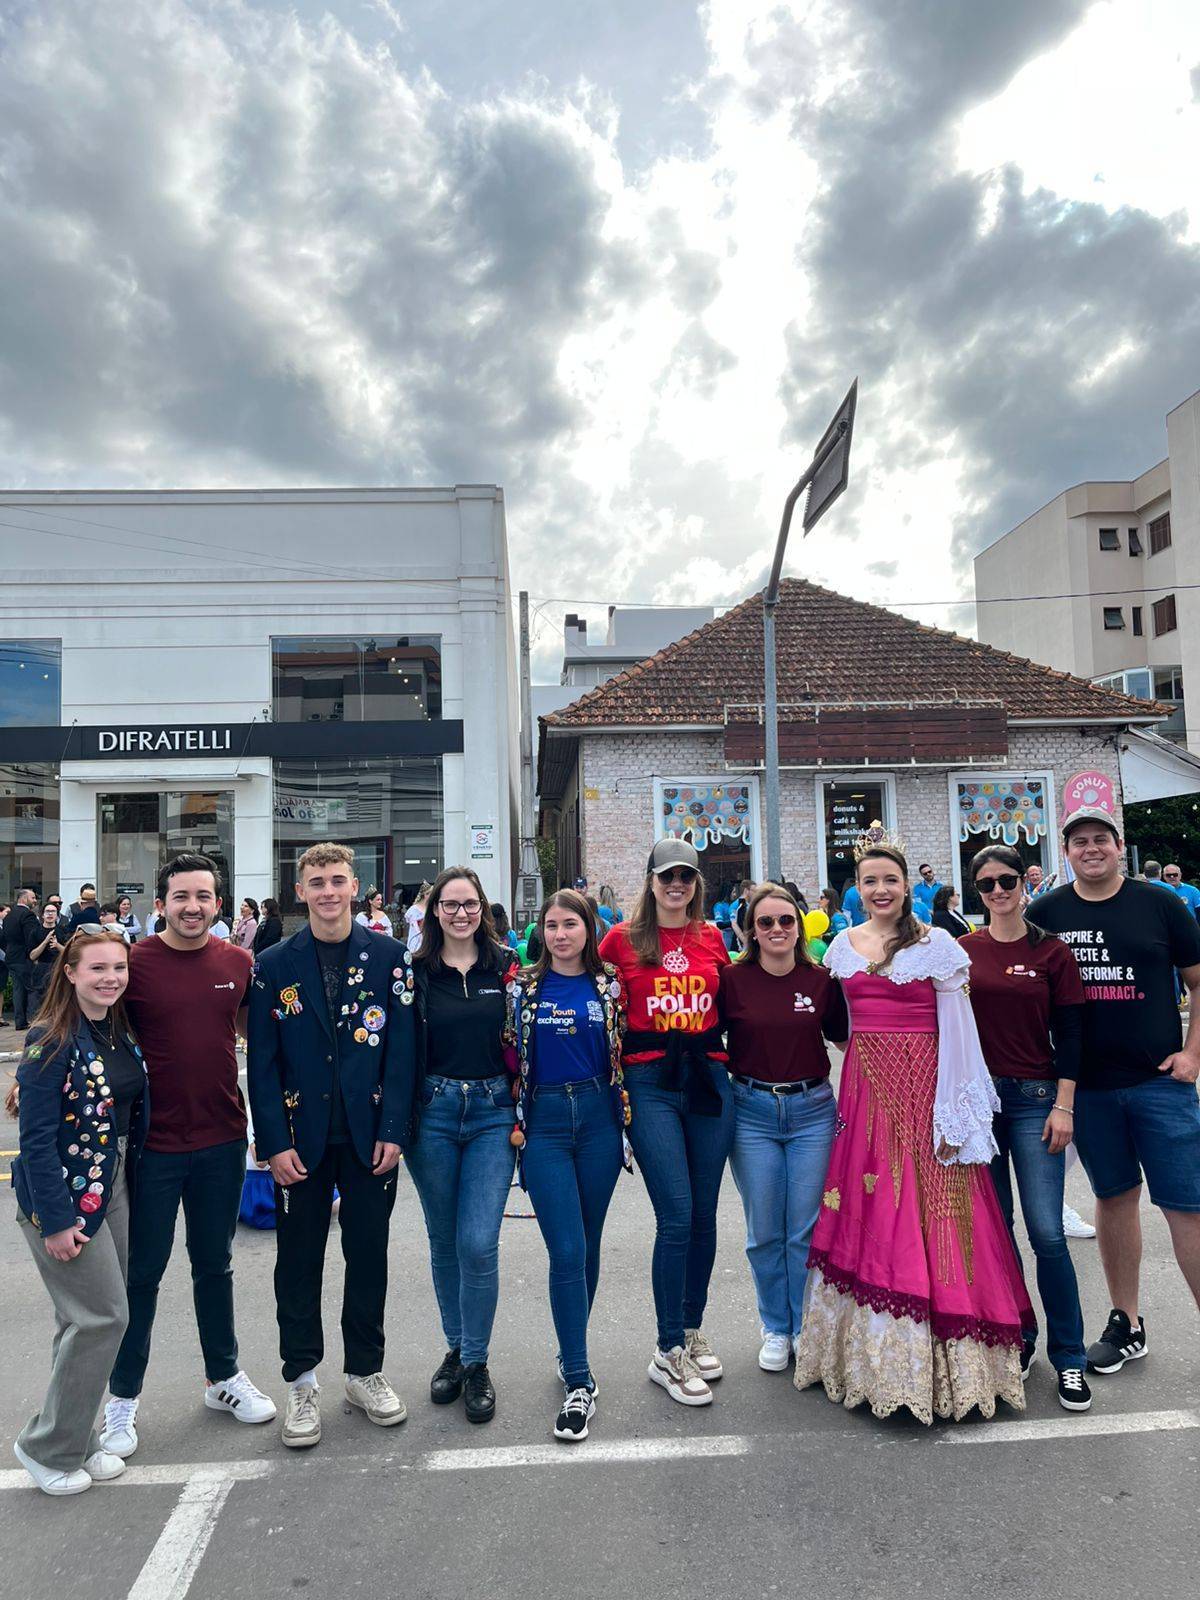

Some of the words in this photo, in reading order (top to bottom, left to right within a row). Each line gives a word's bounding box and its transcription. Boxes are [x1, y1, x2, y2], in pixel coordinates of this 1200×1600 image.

[99, 730, 230, 751] DIFRATELLI
[1072, 777, 1107, 799] DONUT
[850, 816, 856, 824] &
[1096, 931, 1104, 943] &
[1071, 948, 1099, 962] ECTE
[1101, 949, 1110, 962] &
[1079, 966, 1124, 981] SFORME
[1126, 967, 1134, 981] &
[654, 975, 706, 997] END
[646, 993, 712, 1017] POLIO
[552, 1009, 576, 1017] youth
[537, 1016, 574, 1026] exchange
[655, 1011, 706, 1032] NOW
